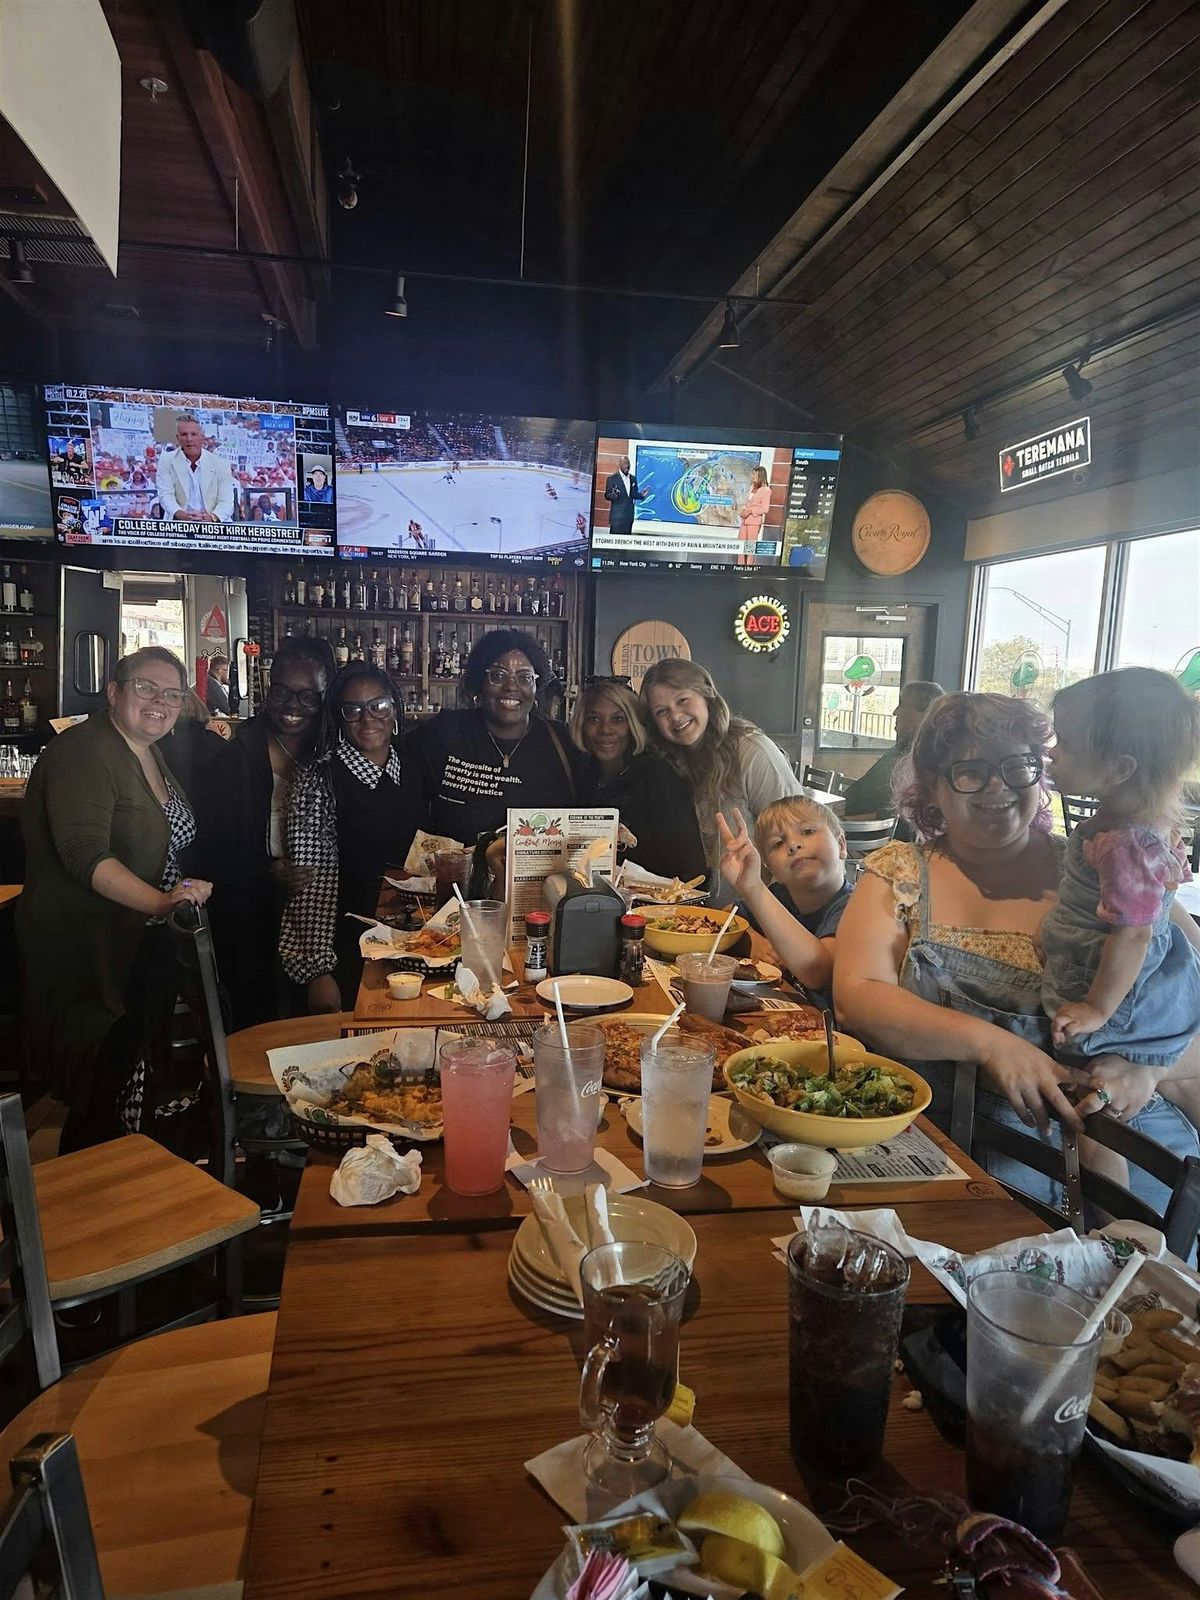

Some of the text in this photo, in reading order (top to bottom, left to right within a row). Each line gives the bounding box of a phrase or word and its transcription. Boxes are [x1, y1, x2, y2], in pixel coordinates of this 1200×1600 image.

[1016, 427, 1086, 468] TEREMANA
[1021, 451, 1080, 479] SMALL BATCH TEQUILA
[118, 520, 300, 539] COLLEGE GAMEDAY HOST KIRK HERBSTREIT
[858, 523, 920, 542] Crown Royal
[170, 541, 197, 549] stooges
[198, 542, 221, 551] talking
[302, 547, 323, 555] sports
[746, 614, 780, 632] ACE
[632, 643, 682, 662] TOWN
[448, 755, 460, 764] The
[461, 760, 492, 772] opposite
[444, 771, 456, 780] The
[456, 775, 489, 788] opposite
[445, 764, 523, 784] poverty is not wealth.
[441, 779, 467, 792] poverty
[475, 787, 503, 797] justice
[542, 838, 562, 847] Menu
